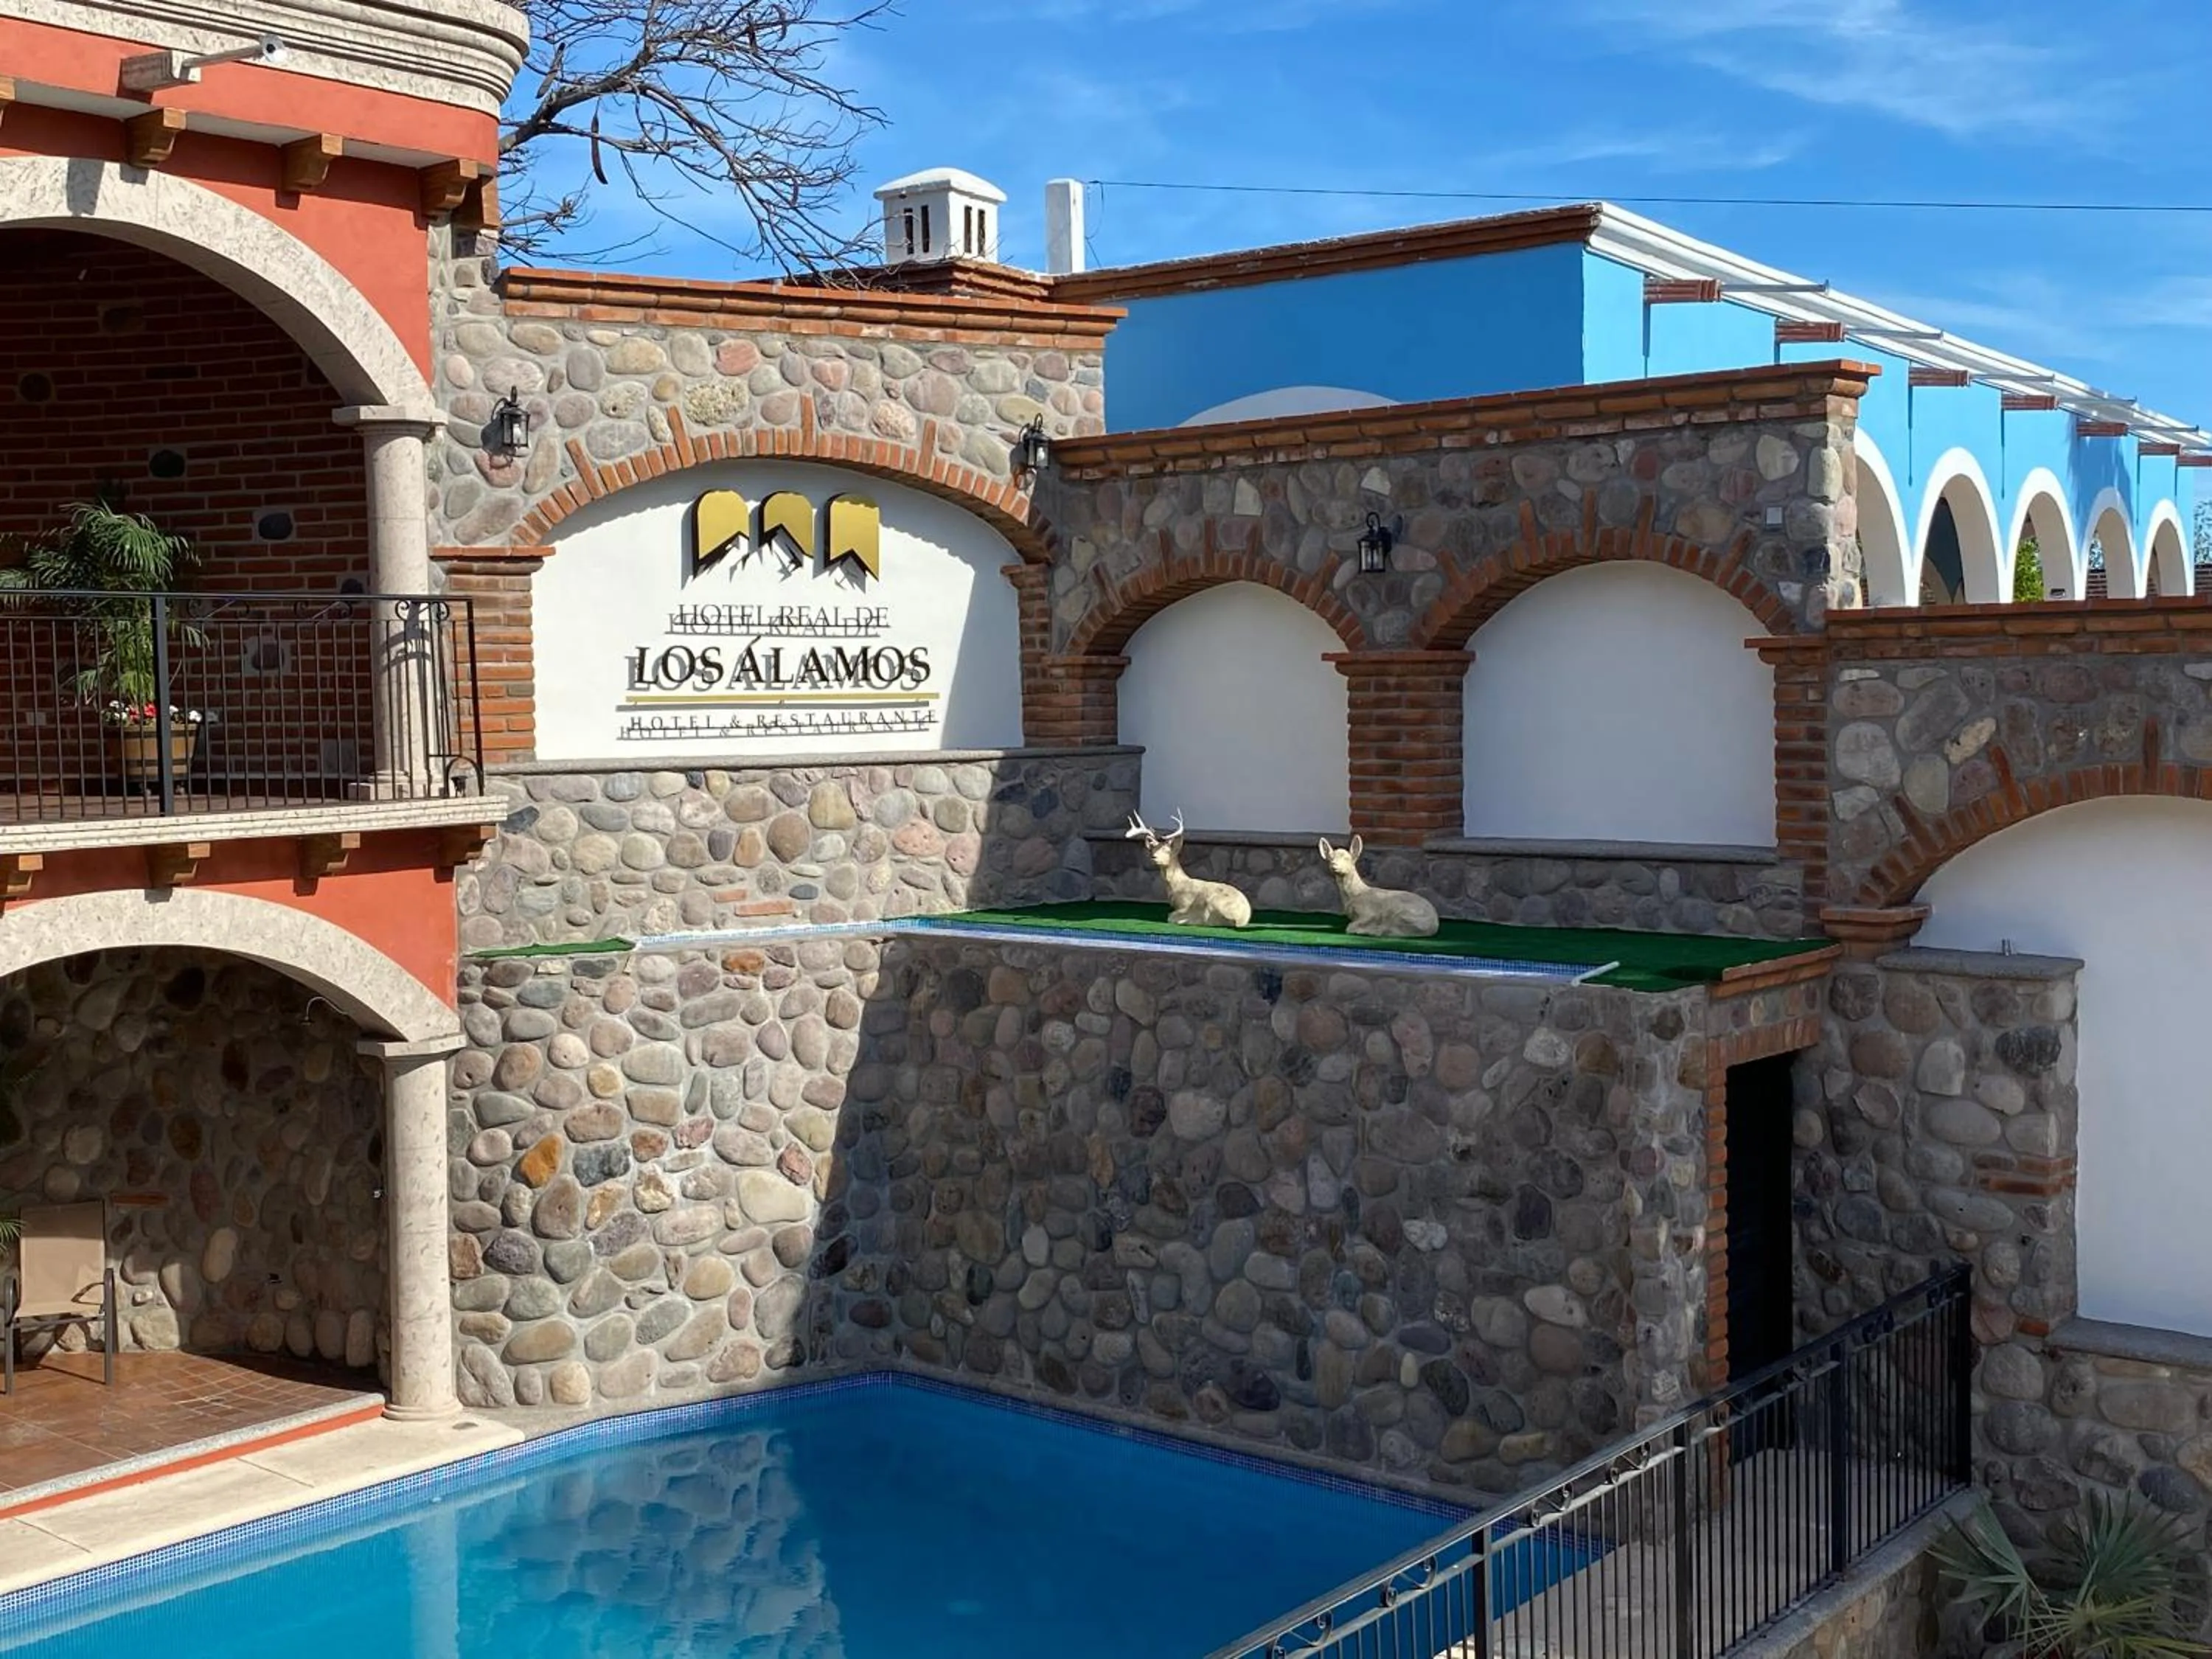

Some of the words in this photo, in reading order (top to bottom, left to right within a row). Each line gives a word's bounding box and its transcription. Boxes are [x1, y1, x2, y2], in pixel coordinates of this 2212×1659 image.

[678, 604, 768, 626] HOTEL
[779, 605, 844, 627] REAL
[855, 606, 889, 627] DE
[634, 645, 724, 684] LOS
[735, 635, 931, 684] ÁLAMOS
[630, 716, 714, 729] HOTEL
[730, 714, 742, 728] &
[757, 710, 937, 728] RESTAURANTE
